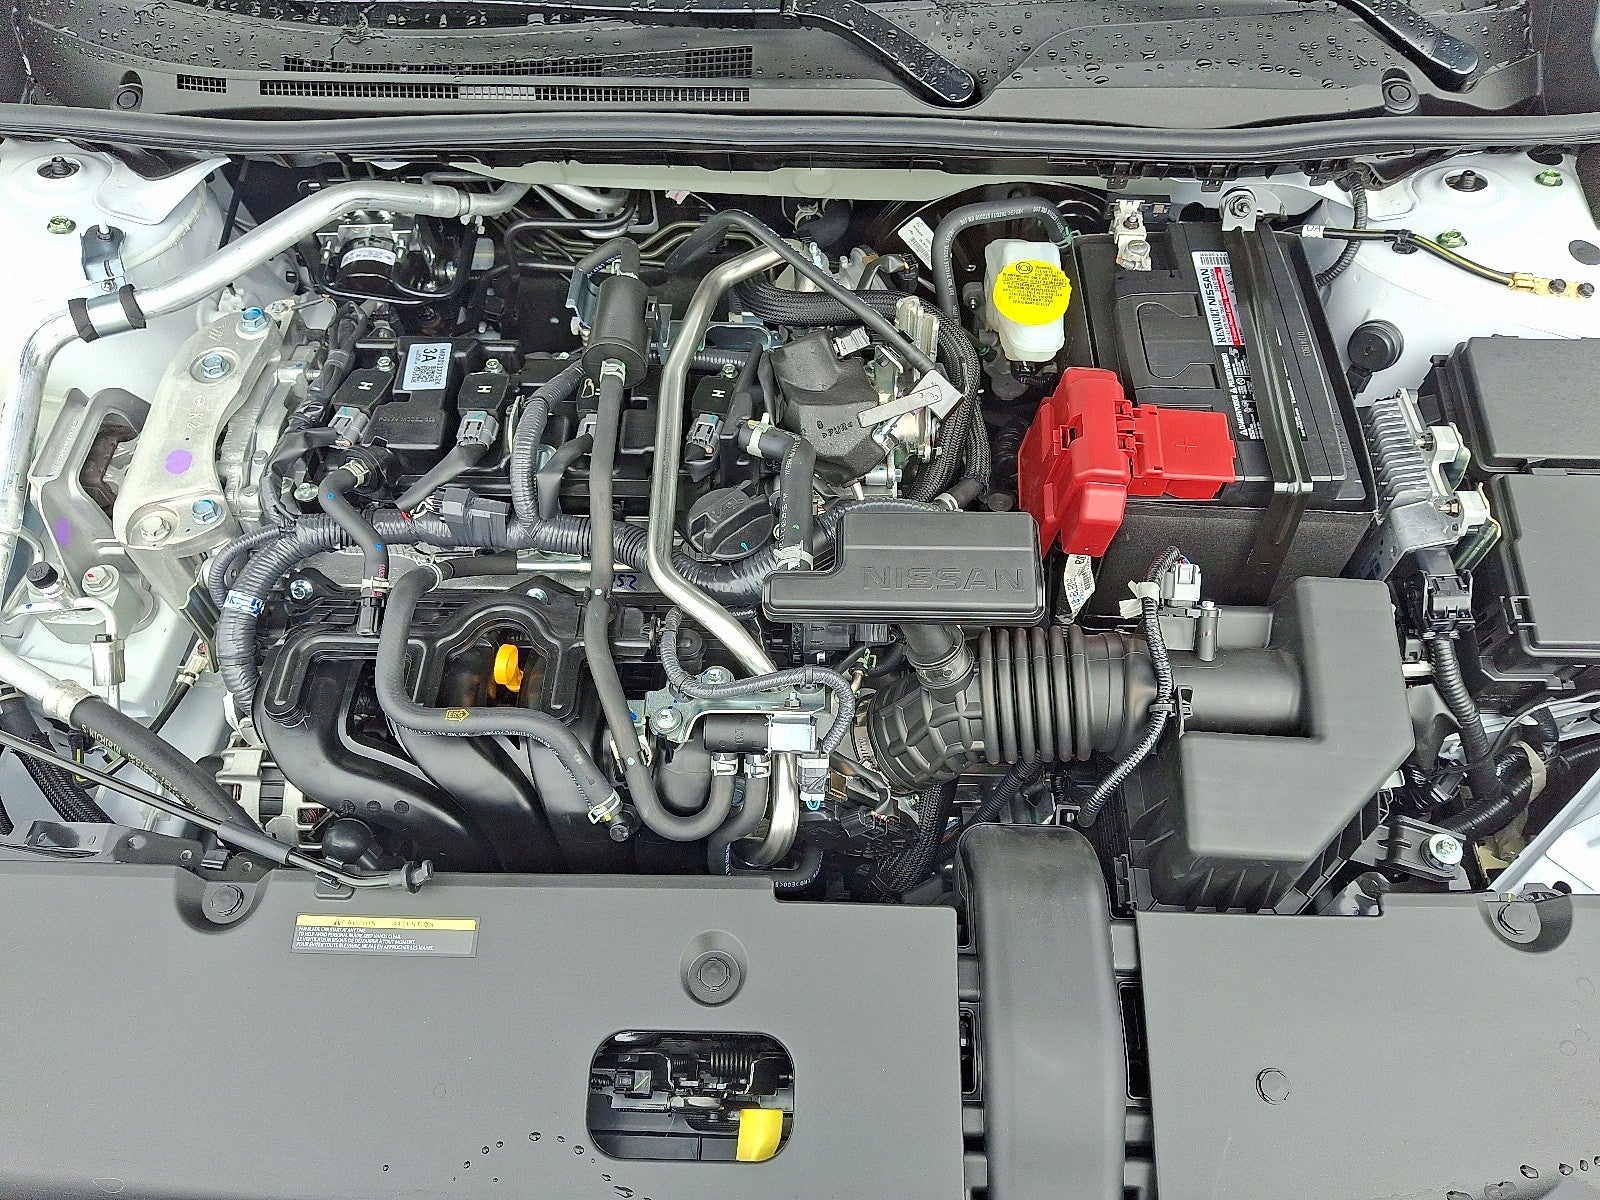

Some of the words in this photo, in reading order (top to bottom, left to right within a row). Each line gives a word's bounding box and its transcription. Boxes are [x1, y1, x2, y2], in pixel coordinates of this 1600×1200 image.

[1200, 269, 1217, 306] NISSAN
[1210, 308, 1226, 343] RENAULT
[423, 348, 438, 363] 3A
[862, 566, 1025, 592] NISSAN
